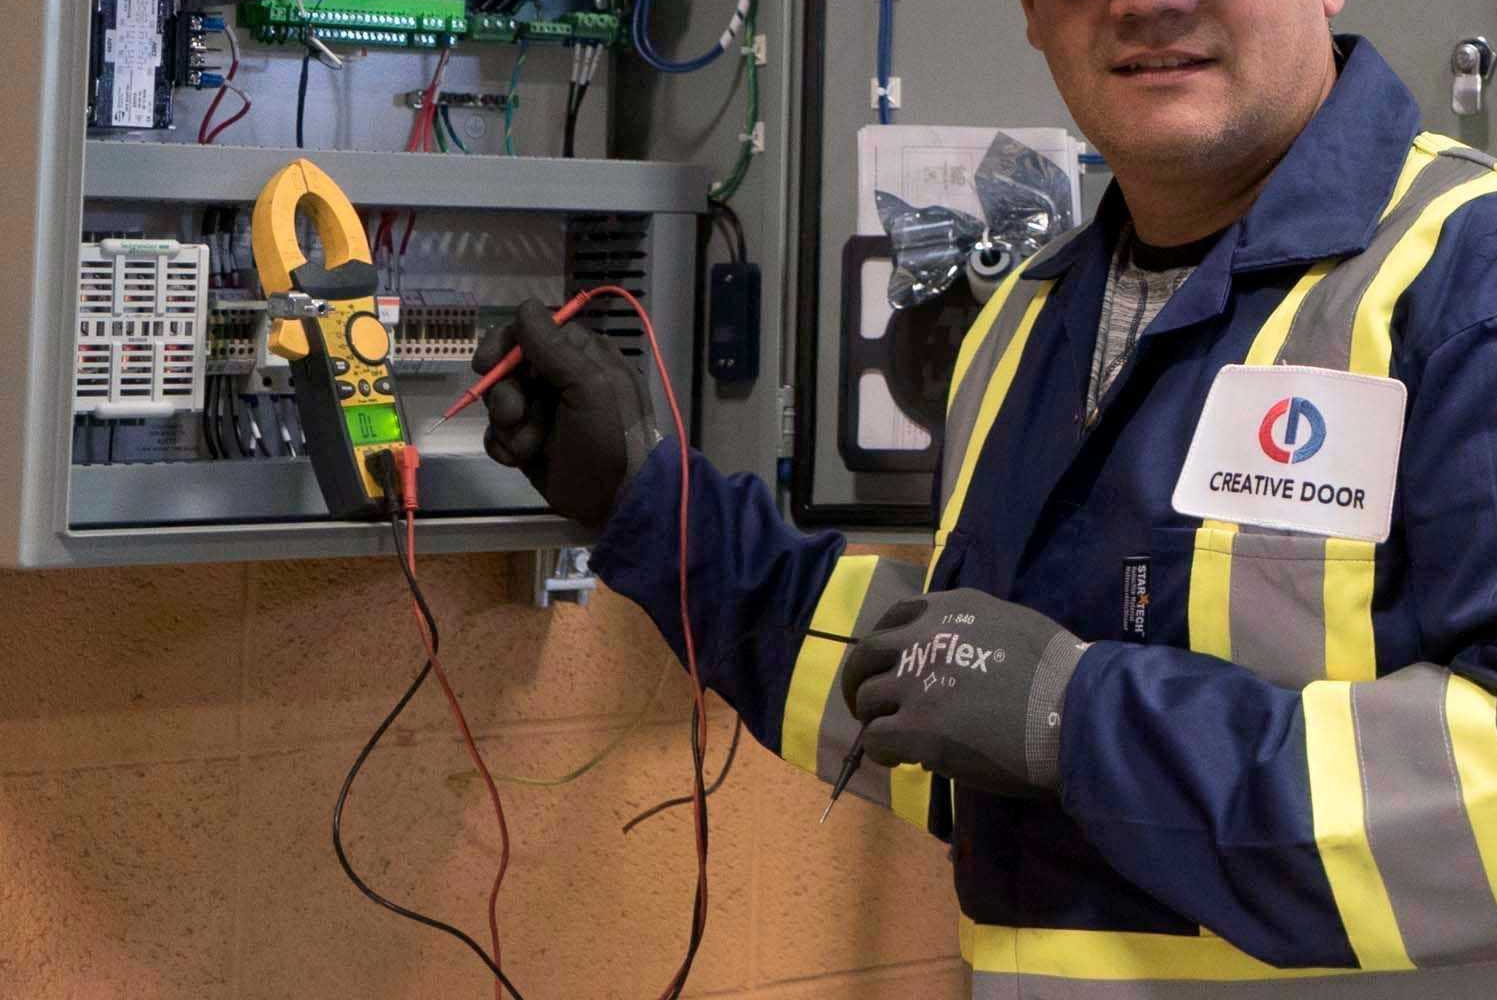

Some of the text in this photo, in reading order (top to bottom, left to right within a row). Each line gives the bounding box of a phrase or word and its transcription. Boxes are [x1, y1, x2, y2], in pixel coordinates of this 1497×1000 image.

[1209, 472, 1365, 510] CREATIVE DOOR
[1136, 564, 1147, 595] STAR
